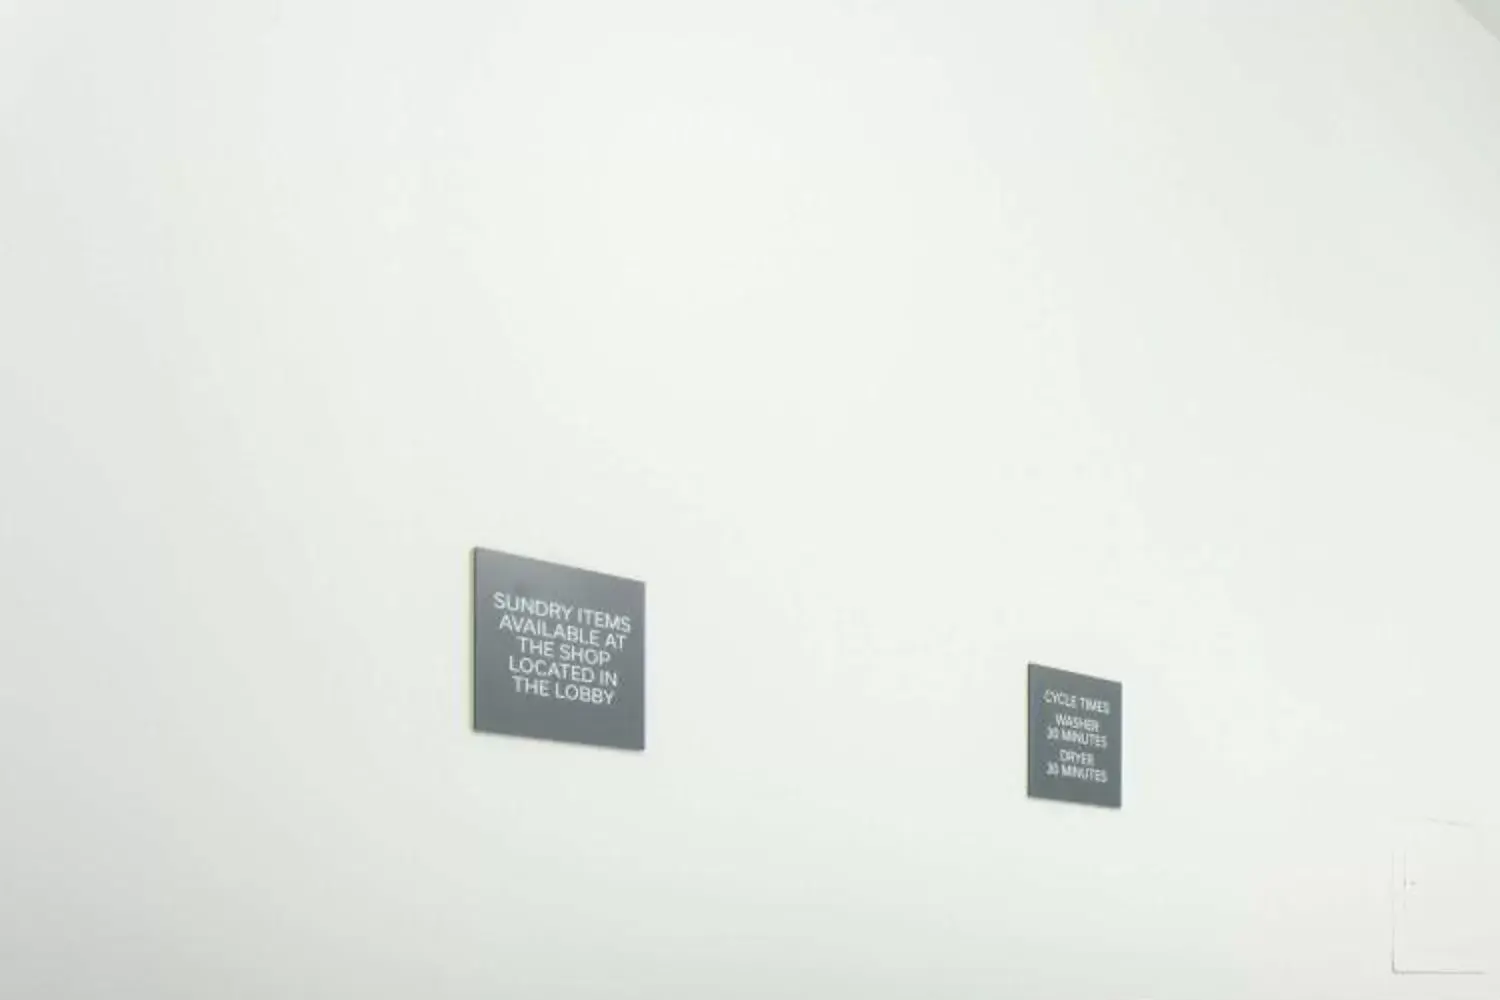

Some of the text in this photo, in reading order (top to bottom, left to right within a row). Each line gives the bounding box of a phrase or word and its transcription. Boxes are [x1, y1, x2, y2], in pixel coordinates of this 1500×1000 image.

[493, 592, 631, 633] SUNDRY ITEMS
[499, 614, 627, 650] AVAILABLE AT
[516, 636, 611, 666] THE SHOP
[508, 656, 617, 687] LOCATED IN
[512, 675, 616, 705] THE LOBBY
[1043, 689, 1111, 715] CYCLE TIMES
[1055, 713, 1099, 732] WASHER
[1061, 728, 1108, 749] MINUTES
[1059, 749, 1095, 766] DRYER
[1061, 765, 1108, 783] MINUTES
